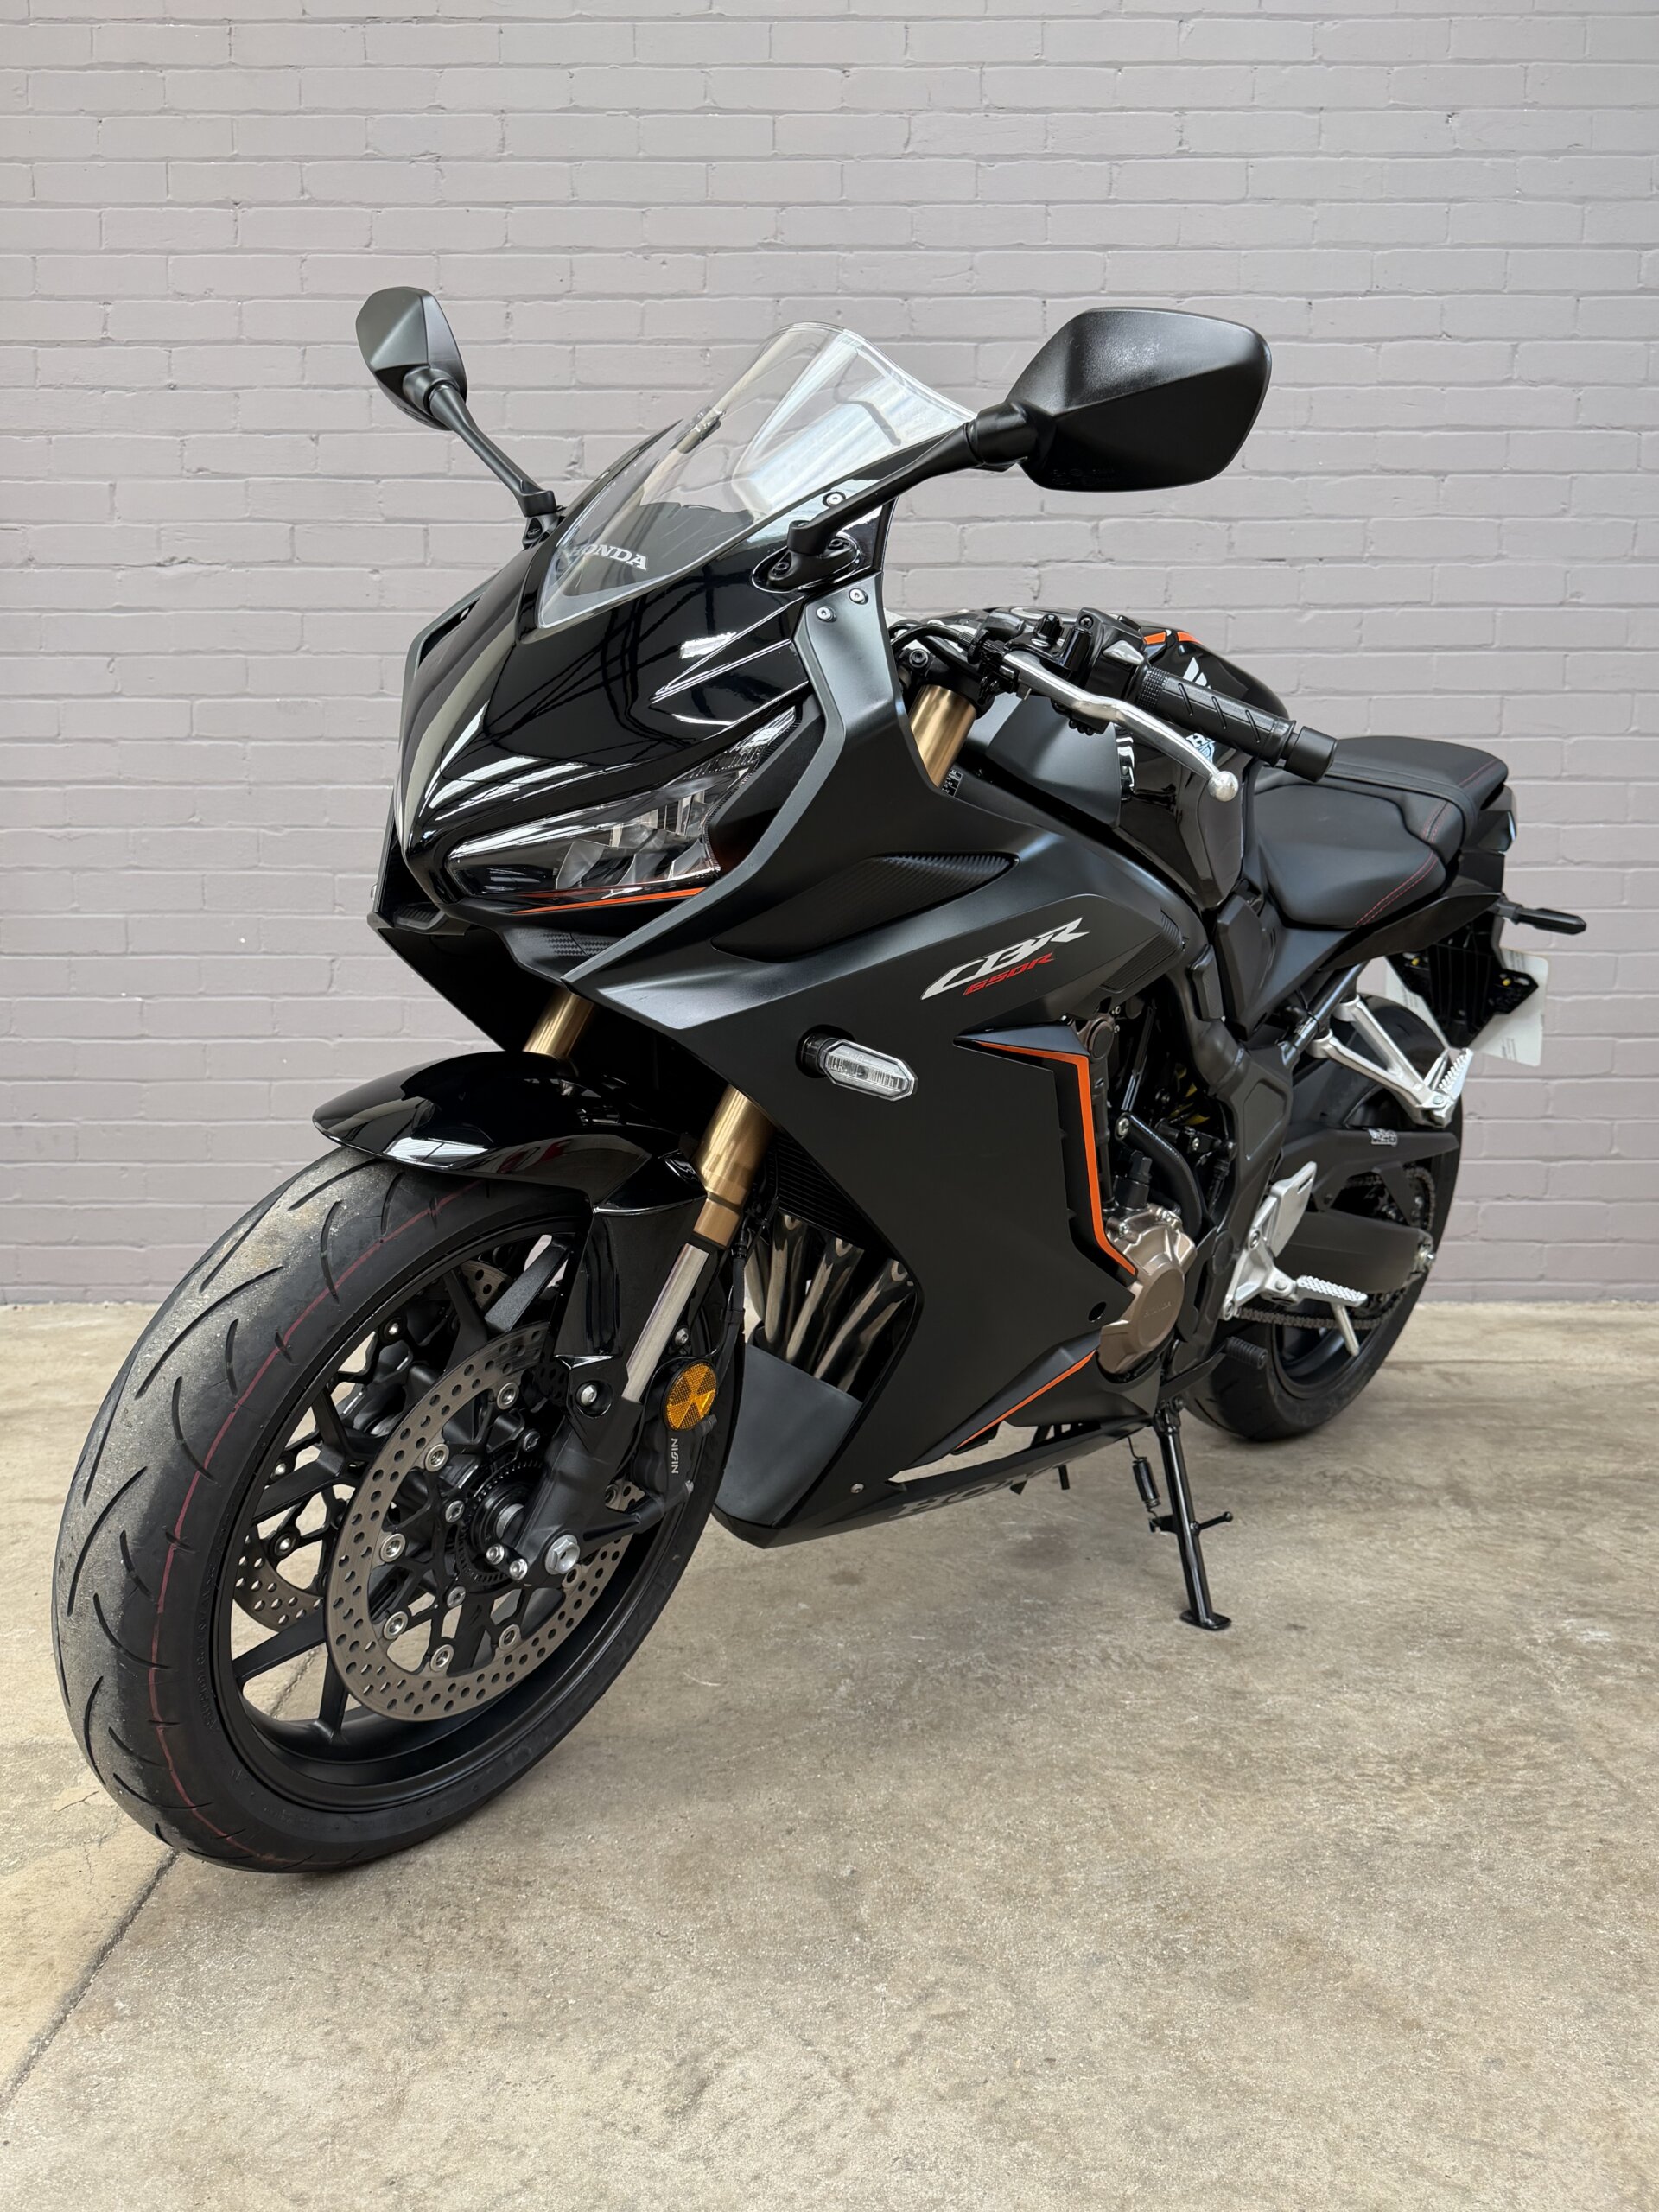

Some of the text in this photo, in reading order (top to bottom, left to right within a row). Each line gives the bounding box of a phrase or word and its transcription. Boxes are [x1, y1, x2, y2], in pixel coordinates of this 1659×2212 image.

[920, 917, 1090, 1001] CBR
[962, 951, 1055, 996] 650R
[671, 1437, 679, 1474] NISSIN
